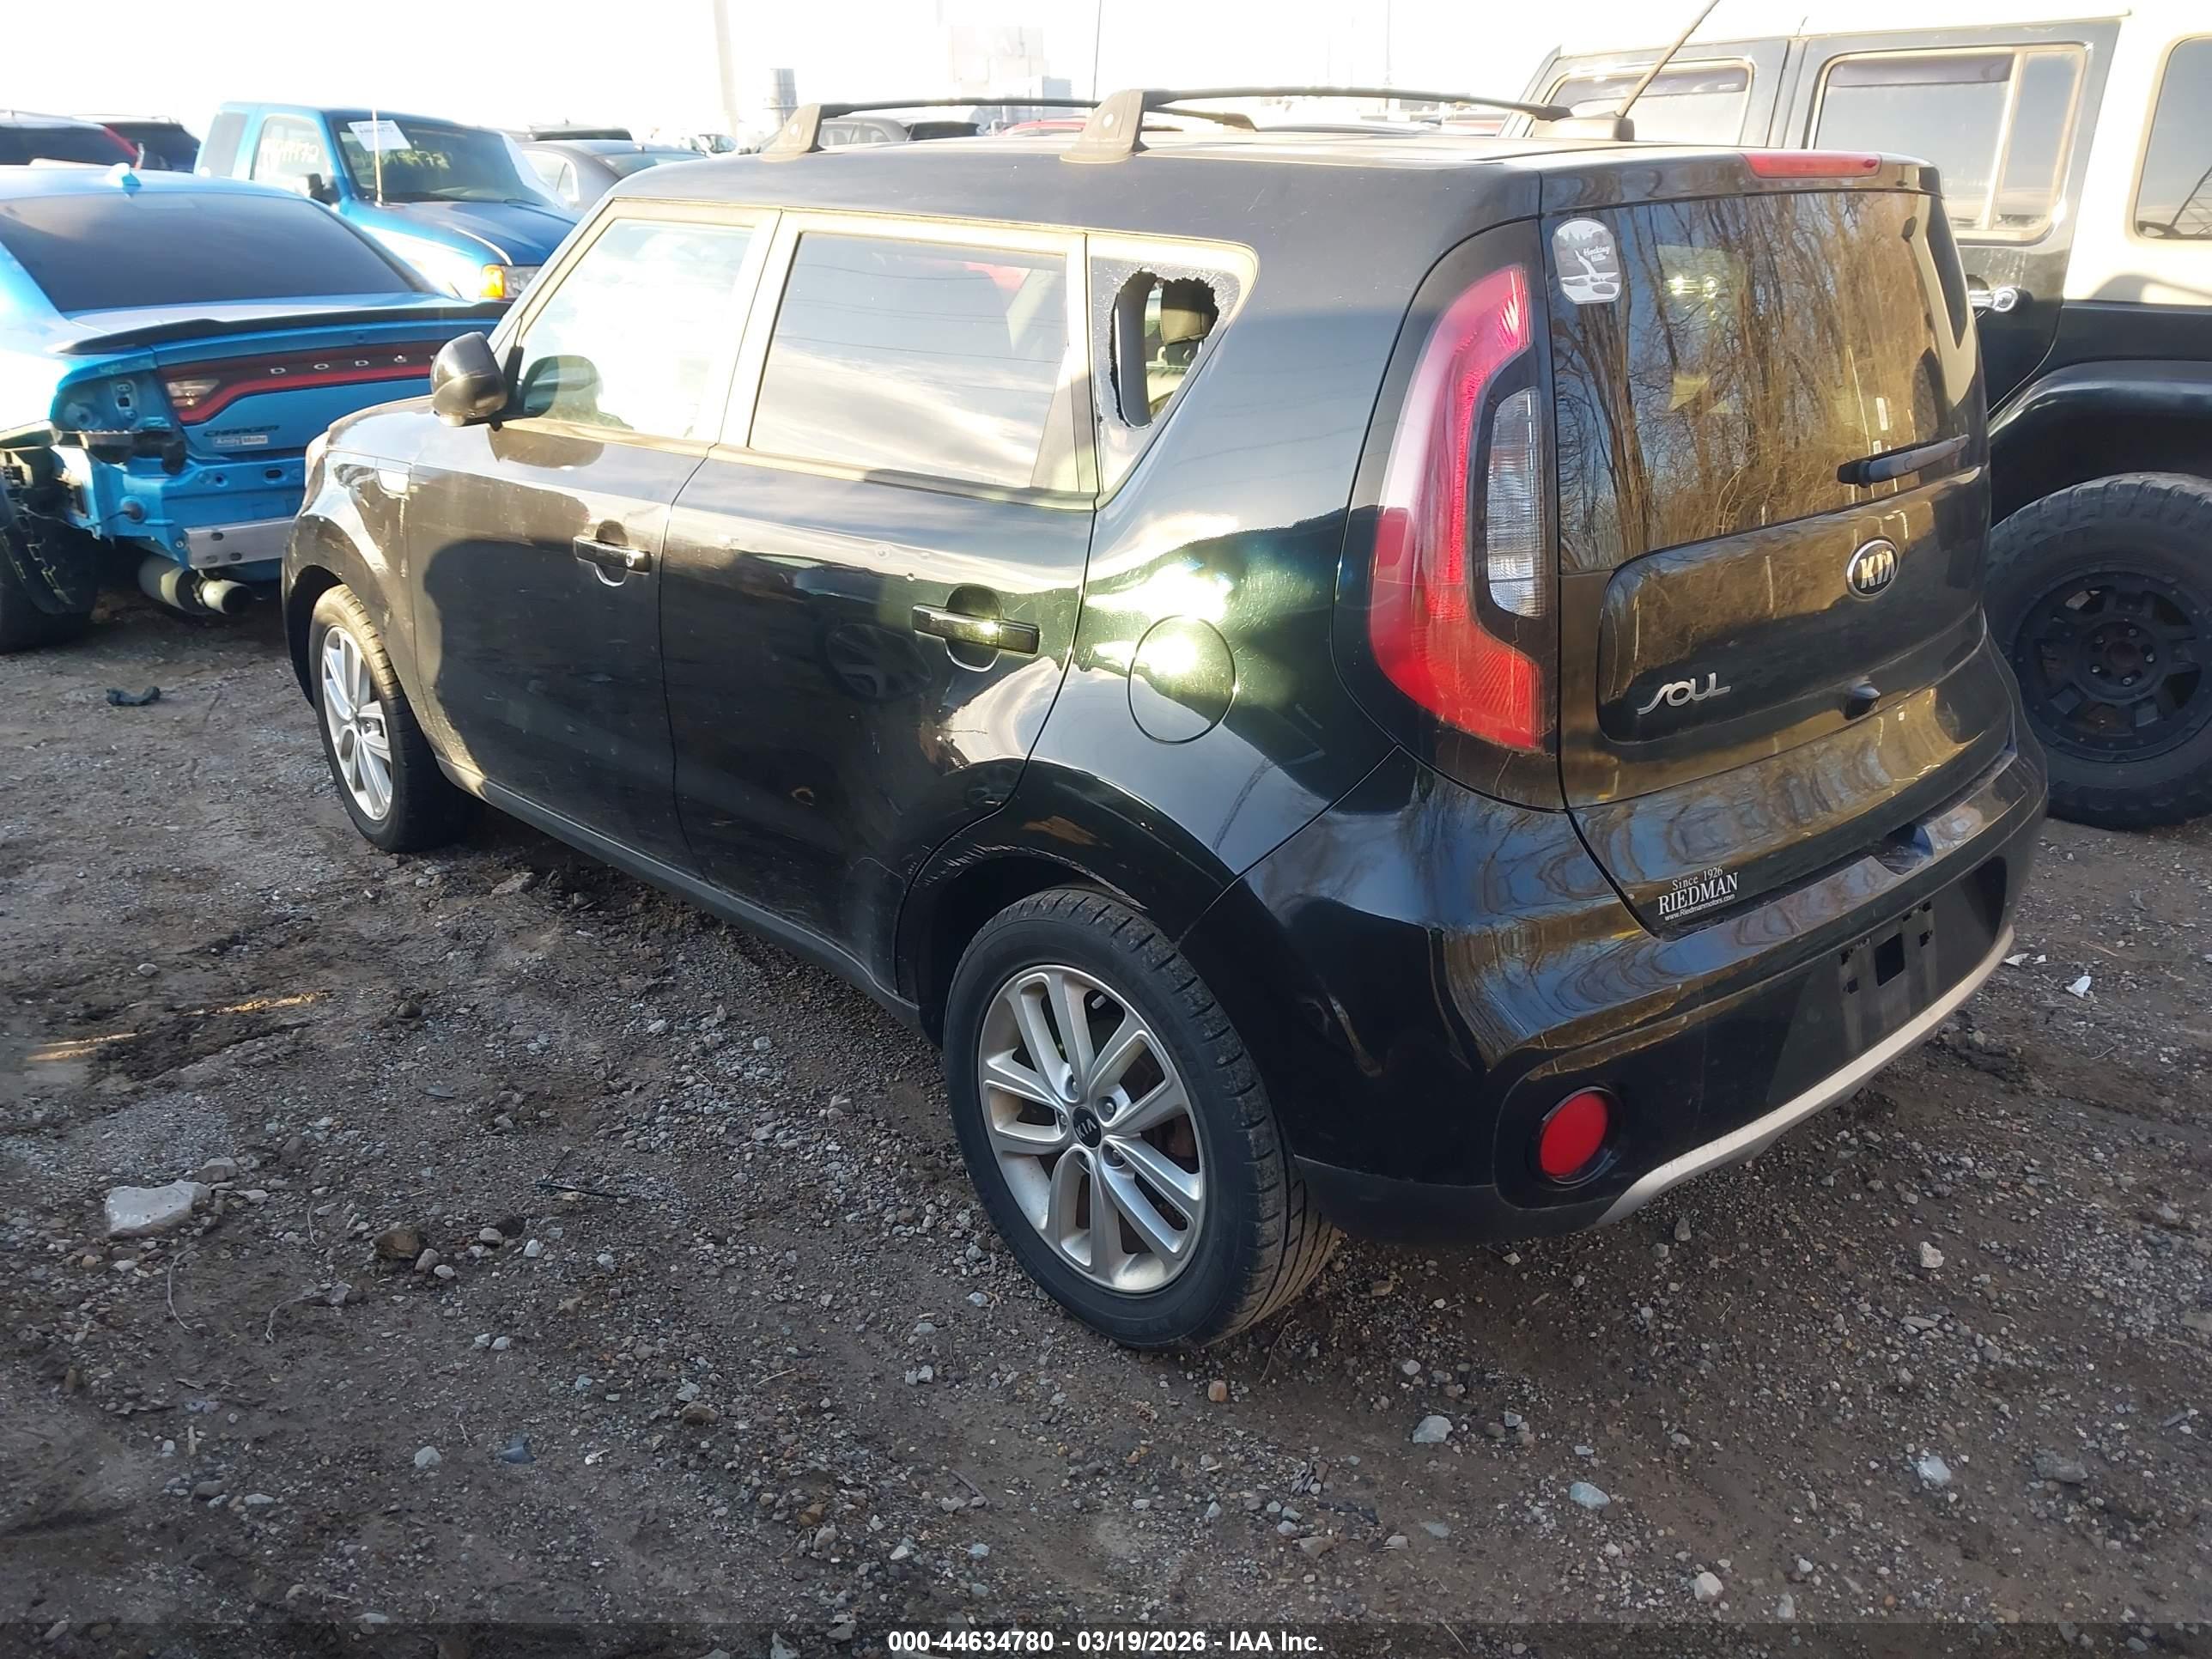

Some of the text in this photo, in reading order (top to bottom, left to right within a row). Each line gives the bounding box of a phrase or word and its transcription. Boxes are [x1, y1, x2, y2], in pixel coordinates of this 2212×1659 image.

[270, 354, 436, 375] DODG
[1859, 550, 1895, 589] KIA
[1637, 672, 1731, 714] SOUL
[1672, 866, 1723, 891] Since 1926
[1657, 872, 1739, 915] RIEDMAN
[1664, 894, 1735, 921] www.Riedmanmotors.com
[1075, 1118, 1097, 1139] KIA
